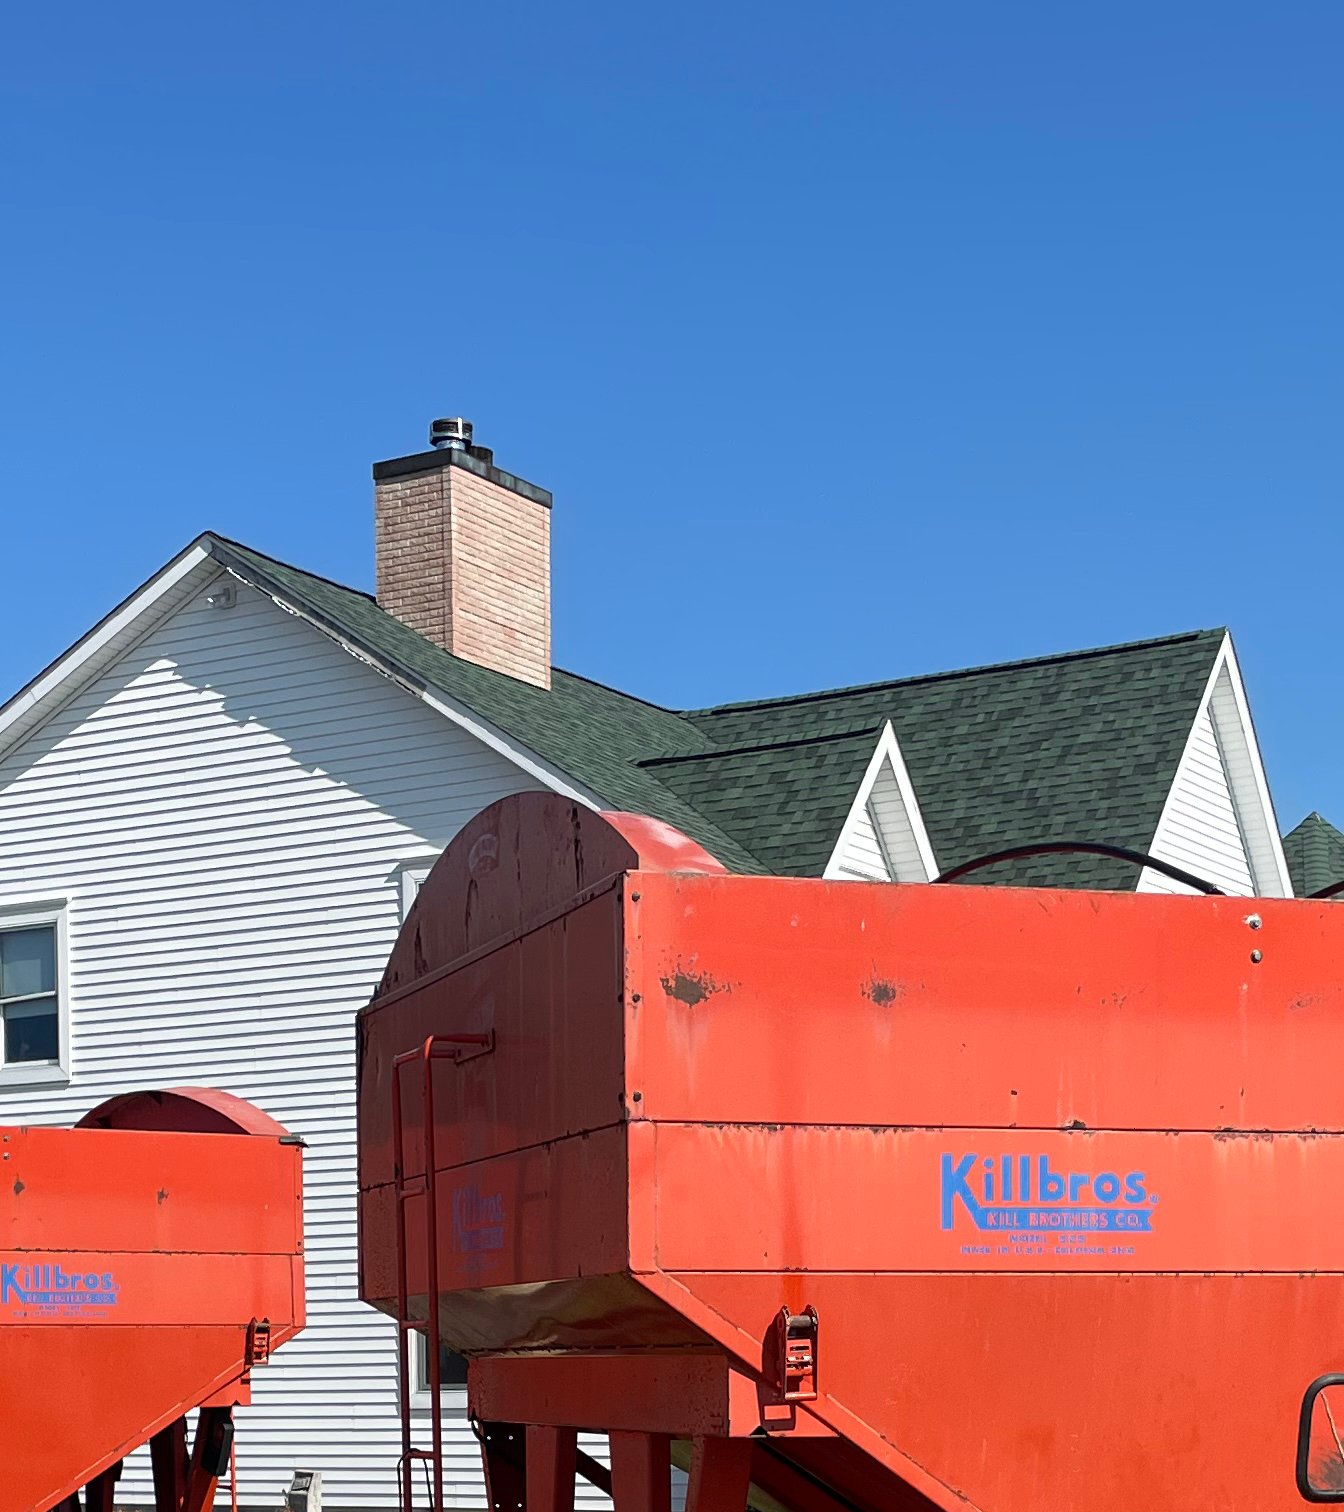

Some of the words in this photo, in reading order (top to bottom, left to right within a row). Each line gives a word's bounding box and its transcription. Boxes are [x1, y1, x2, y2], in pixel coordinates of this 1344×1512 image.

[941, 1153, 1147, 1230] Killbros
[987, 1211, 1020, 1228] KILL
[1028, 1211, 1109, 1229] BROTHERS
[1, 1264, 113, 1303] Killbros
